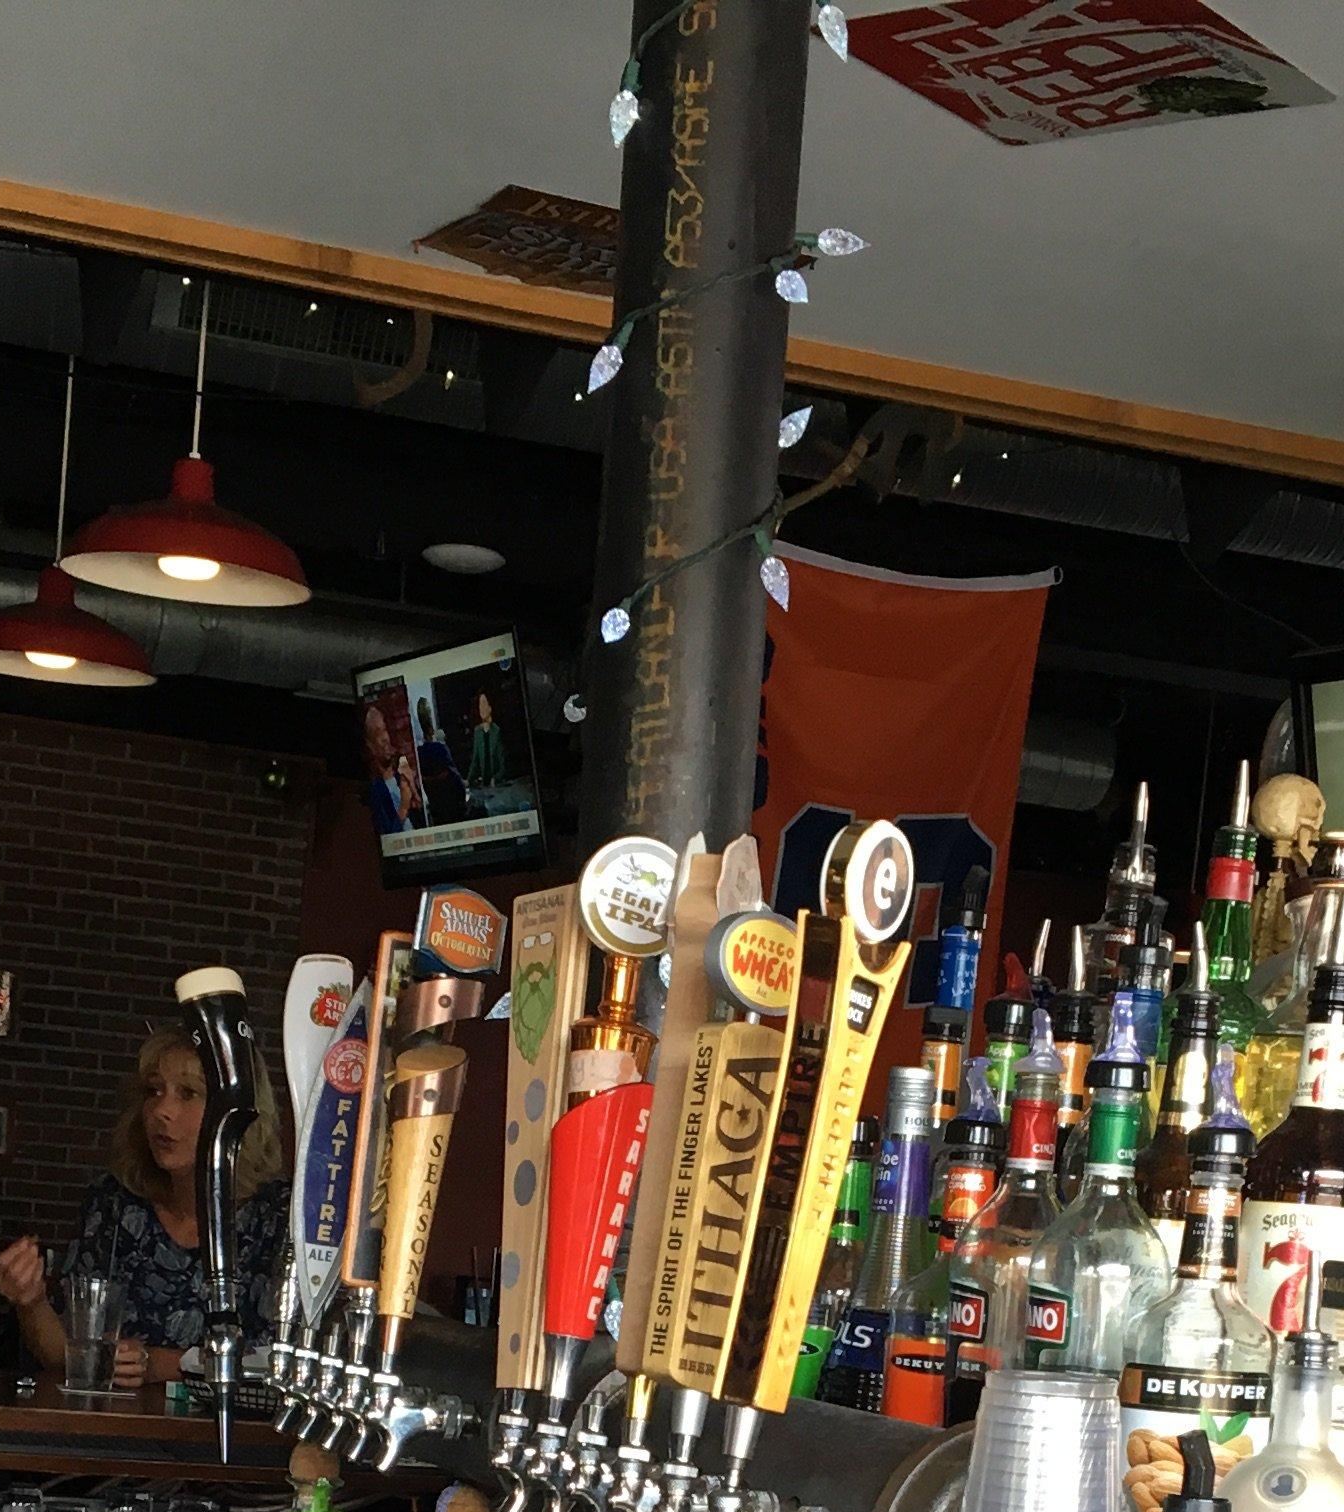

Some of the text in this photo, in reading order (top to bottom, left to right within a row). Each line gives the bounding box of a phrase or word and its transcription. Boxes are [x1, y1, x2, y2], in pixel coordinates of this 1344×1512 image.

[887, 0, 1164, 130] REBEL
[873, 857, 897, 910] e
[440, 901, 494, 932] SAMUEL
[442, 914, 488, 944] ADAMS
[739, 930, 796, 961] APRICO
[330, 1098, 352, 1158] FAT
[678, 1111, 703, 1181] FINGER
[316, 1163, 344, 1243] TIRE
[403, 1133, 444, 1315] SEASONAL
[586, 1107, 651, 1322] SARANAC
[671, 1182, 692, 1222] THE
[679, 1056, 782, 1350] ITHACA
[307, 1249, 333, 1264] ALE
[666, 1224, 684, 1252] OF
[656, 1258, 680, 1325] SPIRIT
[1262, 1241, 1312, 1333] 7
[649, 1330, 669, 1358] THE
[1146, 1377, 1266, 1401] DE KUYPER
